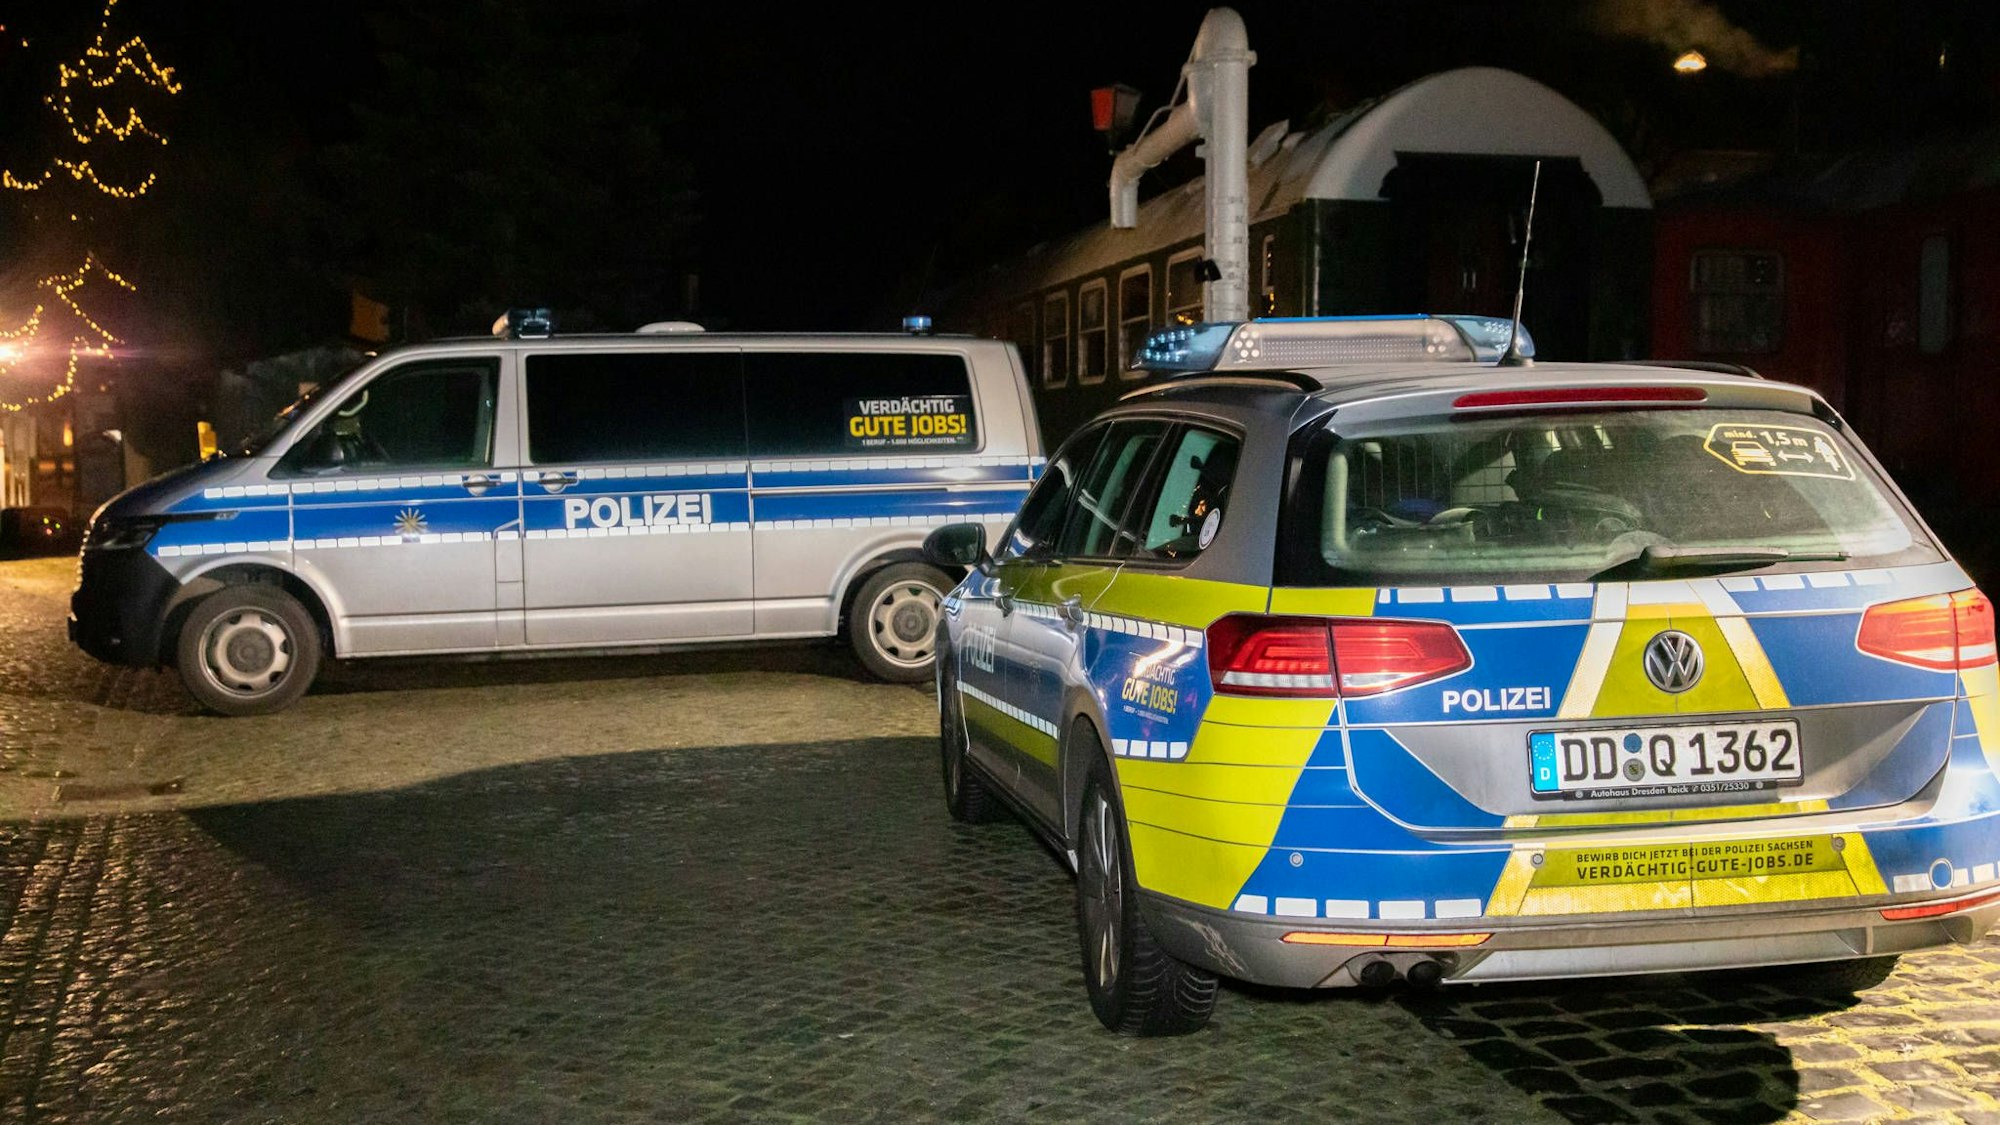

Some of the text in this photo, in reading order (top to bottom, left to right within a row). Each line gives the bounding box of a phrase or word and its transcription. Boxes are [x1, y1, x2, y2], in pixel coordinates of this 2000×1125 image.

[859, 397, 954, 415] VERDÄCHTIG
[850, 414, 967, 437] GUTE JOBS!
[1724, 430, 1808, 447] mind. 1,5 m
[565, 493, 712, 529] POLIZEI
[1122, 677, 1178, 714] GUTE JOBS!
[1442, 686, 1551, 713] POLIZEI
[1540, 729, 1796, 782] D DD Q 1362
[1590, 782, 1749, 798] Autohaus Dresden Reick 0351/25330
[1577, 840, 1813, 863] BEWIRB DICH JETZT BEI DER POLIZEI SACHSEN
[1577, 853, 1814, 880] VERDÄCHTIG-GUTE-JOBS.DE
